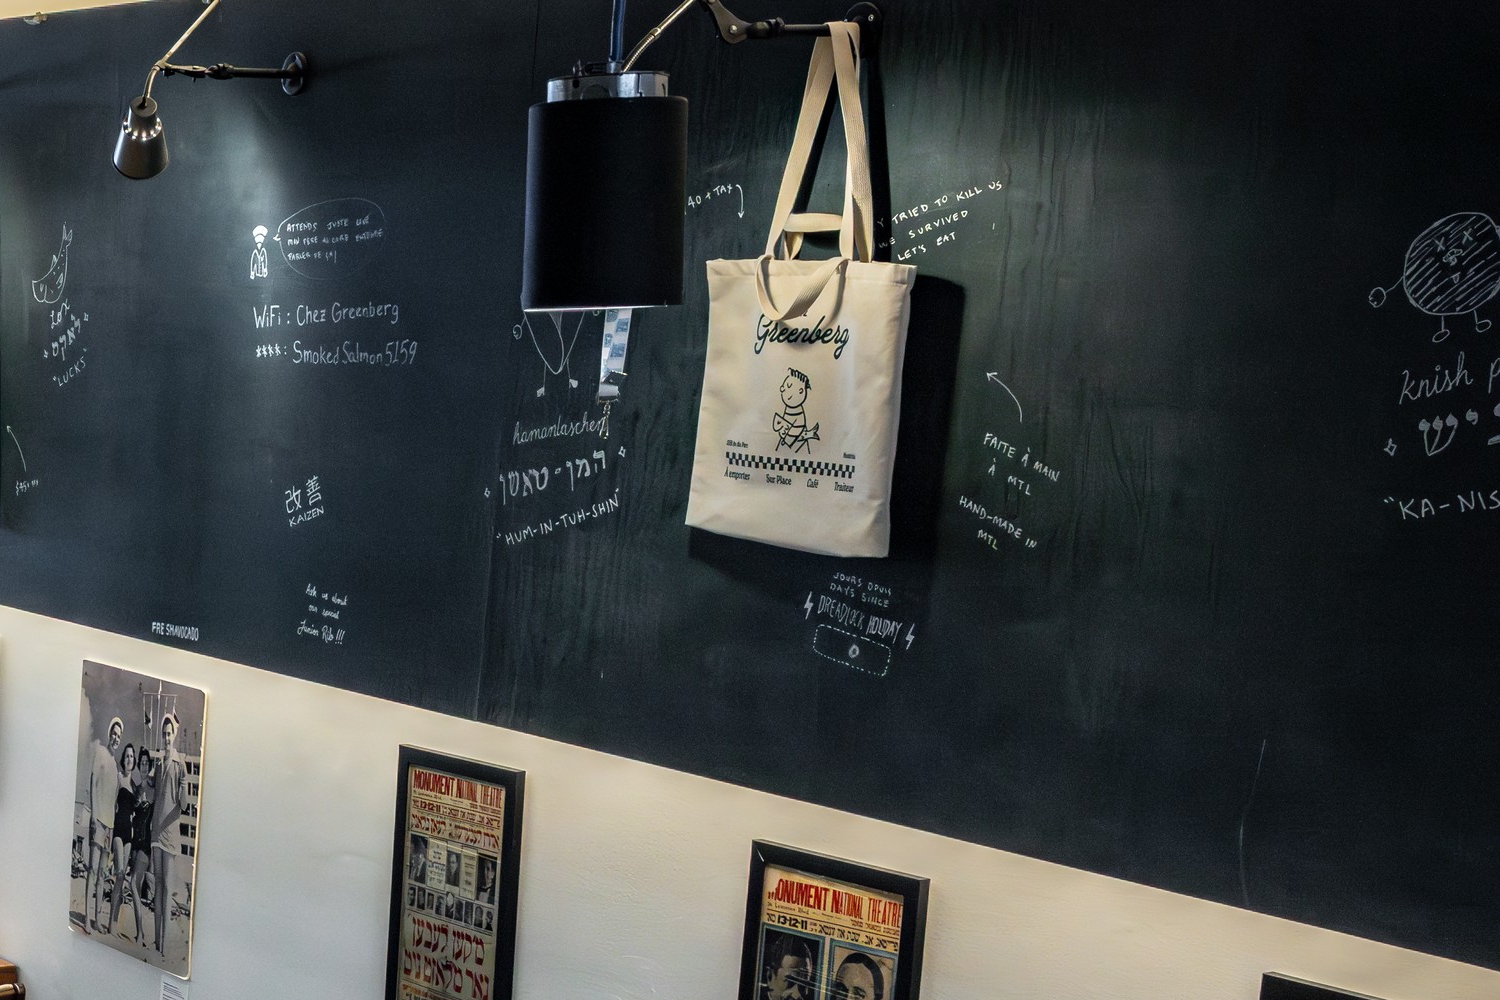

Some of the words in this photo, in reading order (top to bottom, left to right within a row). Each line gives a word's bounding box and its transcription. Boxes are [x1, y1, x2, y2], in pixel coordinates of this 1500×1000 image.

[713, 184, 733, 196] TAX
[892, 203, 929, 226] TRIED
[934, 194, 948, 207] TO
[956, 186, 983, 202] KILL
[988, 180, 1003, 192] US
[908, 209, 969, 240] SURVIVED
[898, 244, 927, 262] LET'S
[936, 231, 956, 246] EAT
[253, 304, 281, 329] WiFi
[296, 304, 327, 326] Chez
[331, 302, 400, 325] Greenberg
[753, 314, 850, 361] Greenberg
[1399, 351, 1474, 405] knish
[983, 432, 1016, 459] FAITE
[1033, 461, 1060, 482] MAIN
[776, 475, 792, 486] Place
[806, 478, 819, 489] Café
[833, 481, 854, 493] Traiteur
[1007, 475, 1031, 496] MTL
[288, 506, 325, 527] KAIZEN
[959, 495, 1023, 539] HAND-MADE
[1025, 538, 1037, 548] IN
[977, 529, 998, 551] MTL
[830, 583, 855, 598] DAYS
[861, 593, 890, 608] SINCE
[865, 615, 904, 644] HOLIDAY
[413, 769, 457, 797] MONUMENT
[831, 889, 864, 920] NATIONAL
[776, 914, 808, 931] 13-12-11
